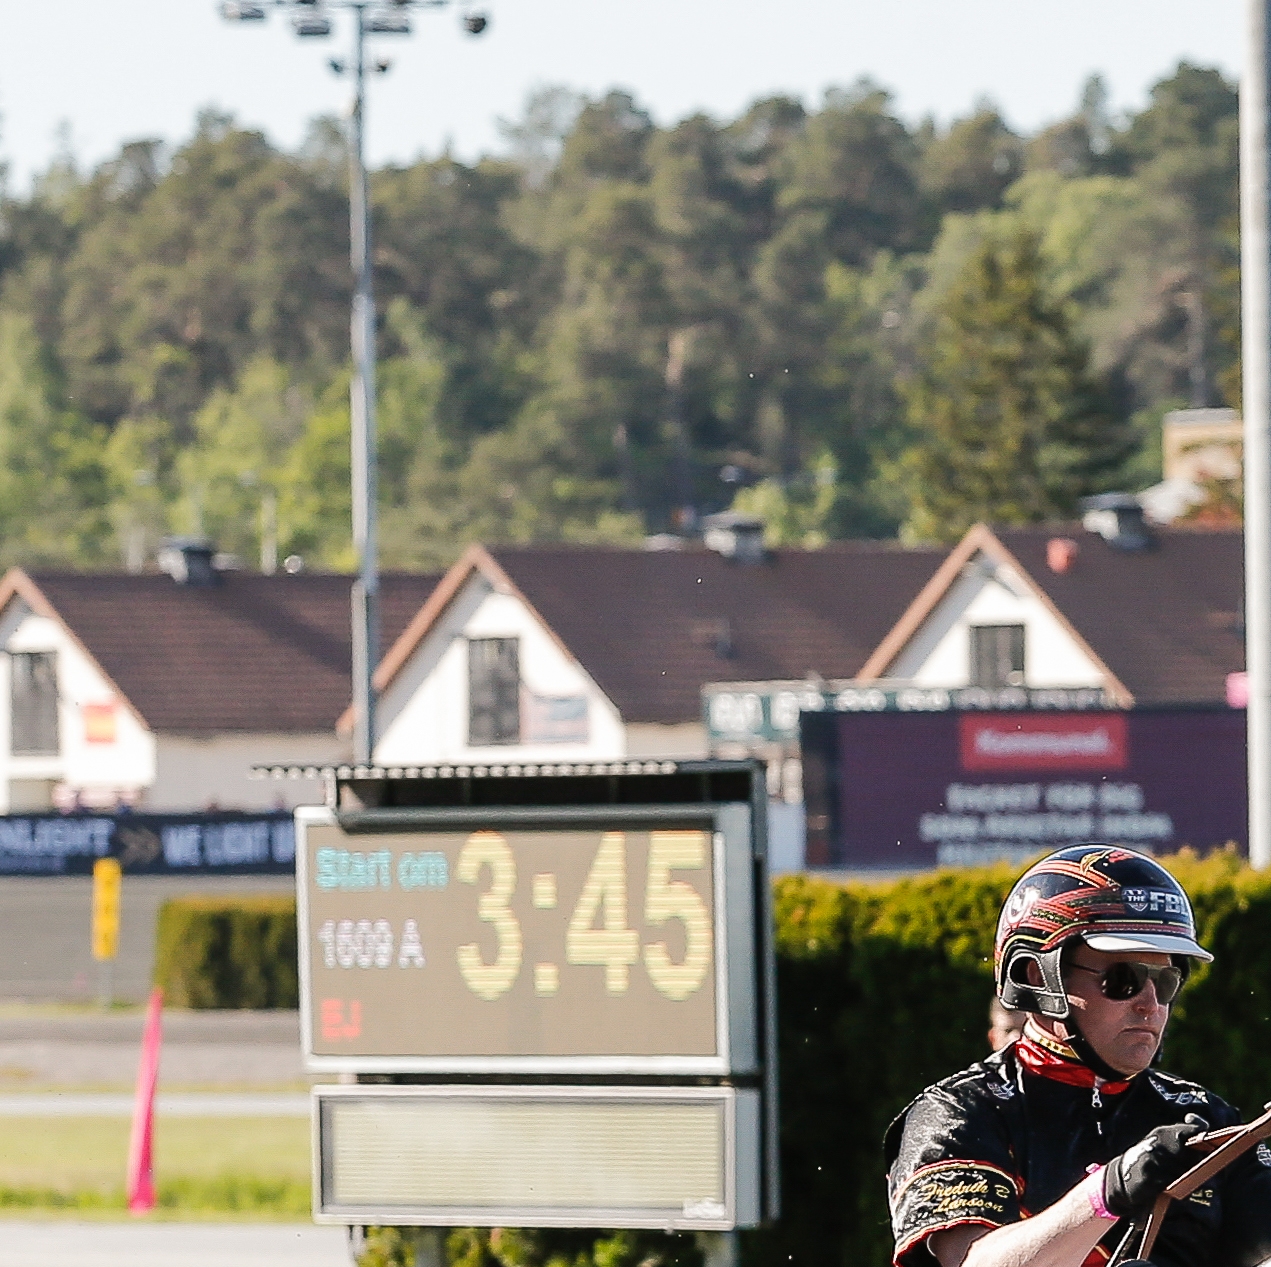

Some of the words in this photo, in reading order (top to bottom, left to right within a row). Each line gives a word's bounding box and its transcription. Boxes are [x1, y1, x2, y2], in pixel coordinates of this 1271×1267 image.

[316, 847, 391, 889] Start
[398, 852, 450, 891] om
[456, 829, 713, 1001] 3:45
[317, 918, 394, 969] 1609
[398, 918, 426, 969] A
